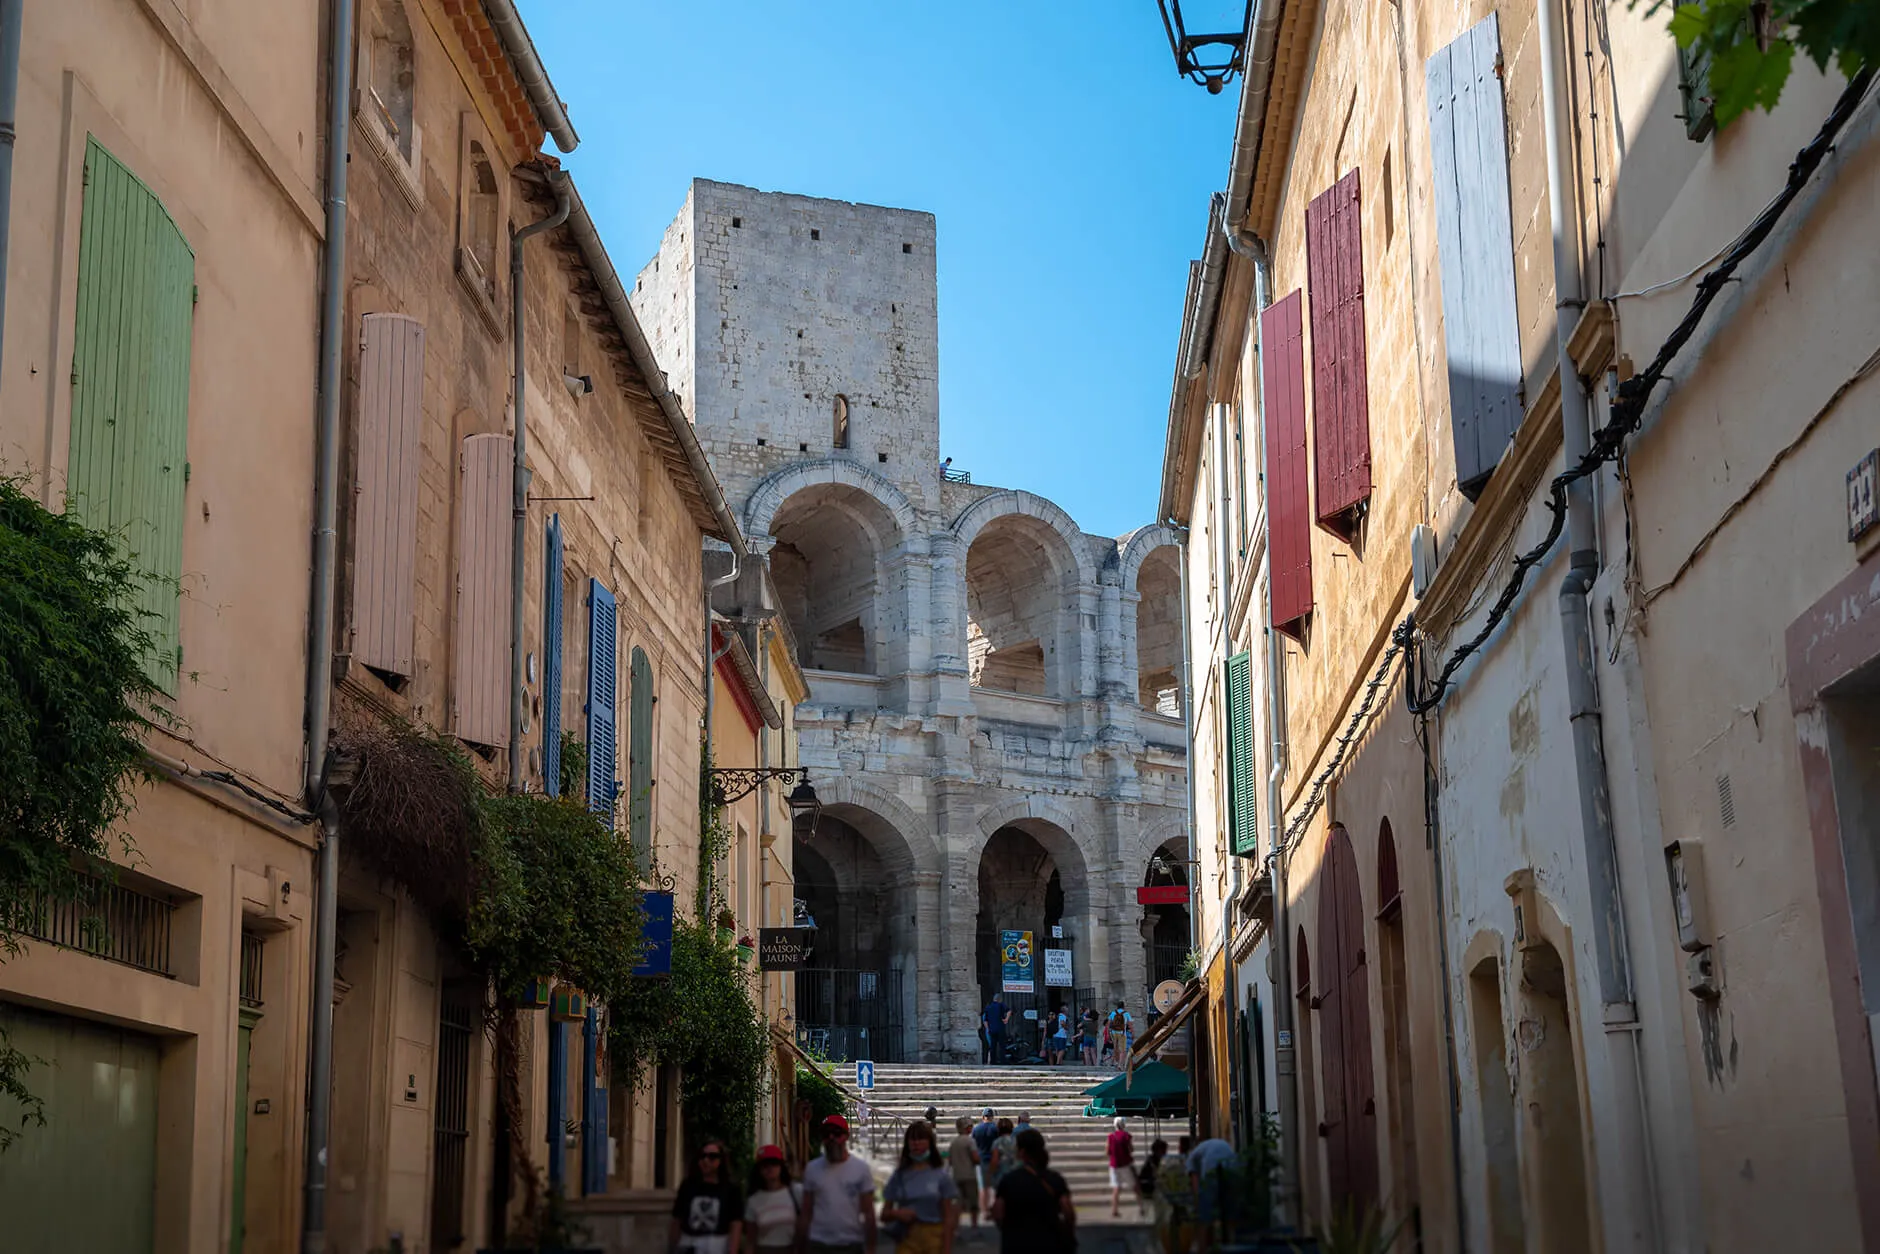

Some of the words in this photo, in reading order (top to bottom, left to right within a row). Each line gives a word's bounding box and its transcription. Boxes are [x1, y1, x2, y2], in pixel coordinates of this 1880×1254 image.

[1852, 476, 1870, 515] 44
[775, 935, 788, 944] LA
[761, 944, 801, 953] MAISON
[765, 954, 798, 963] JAUNE
